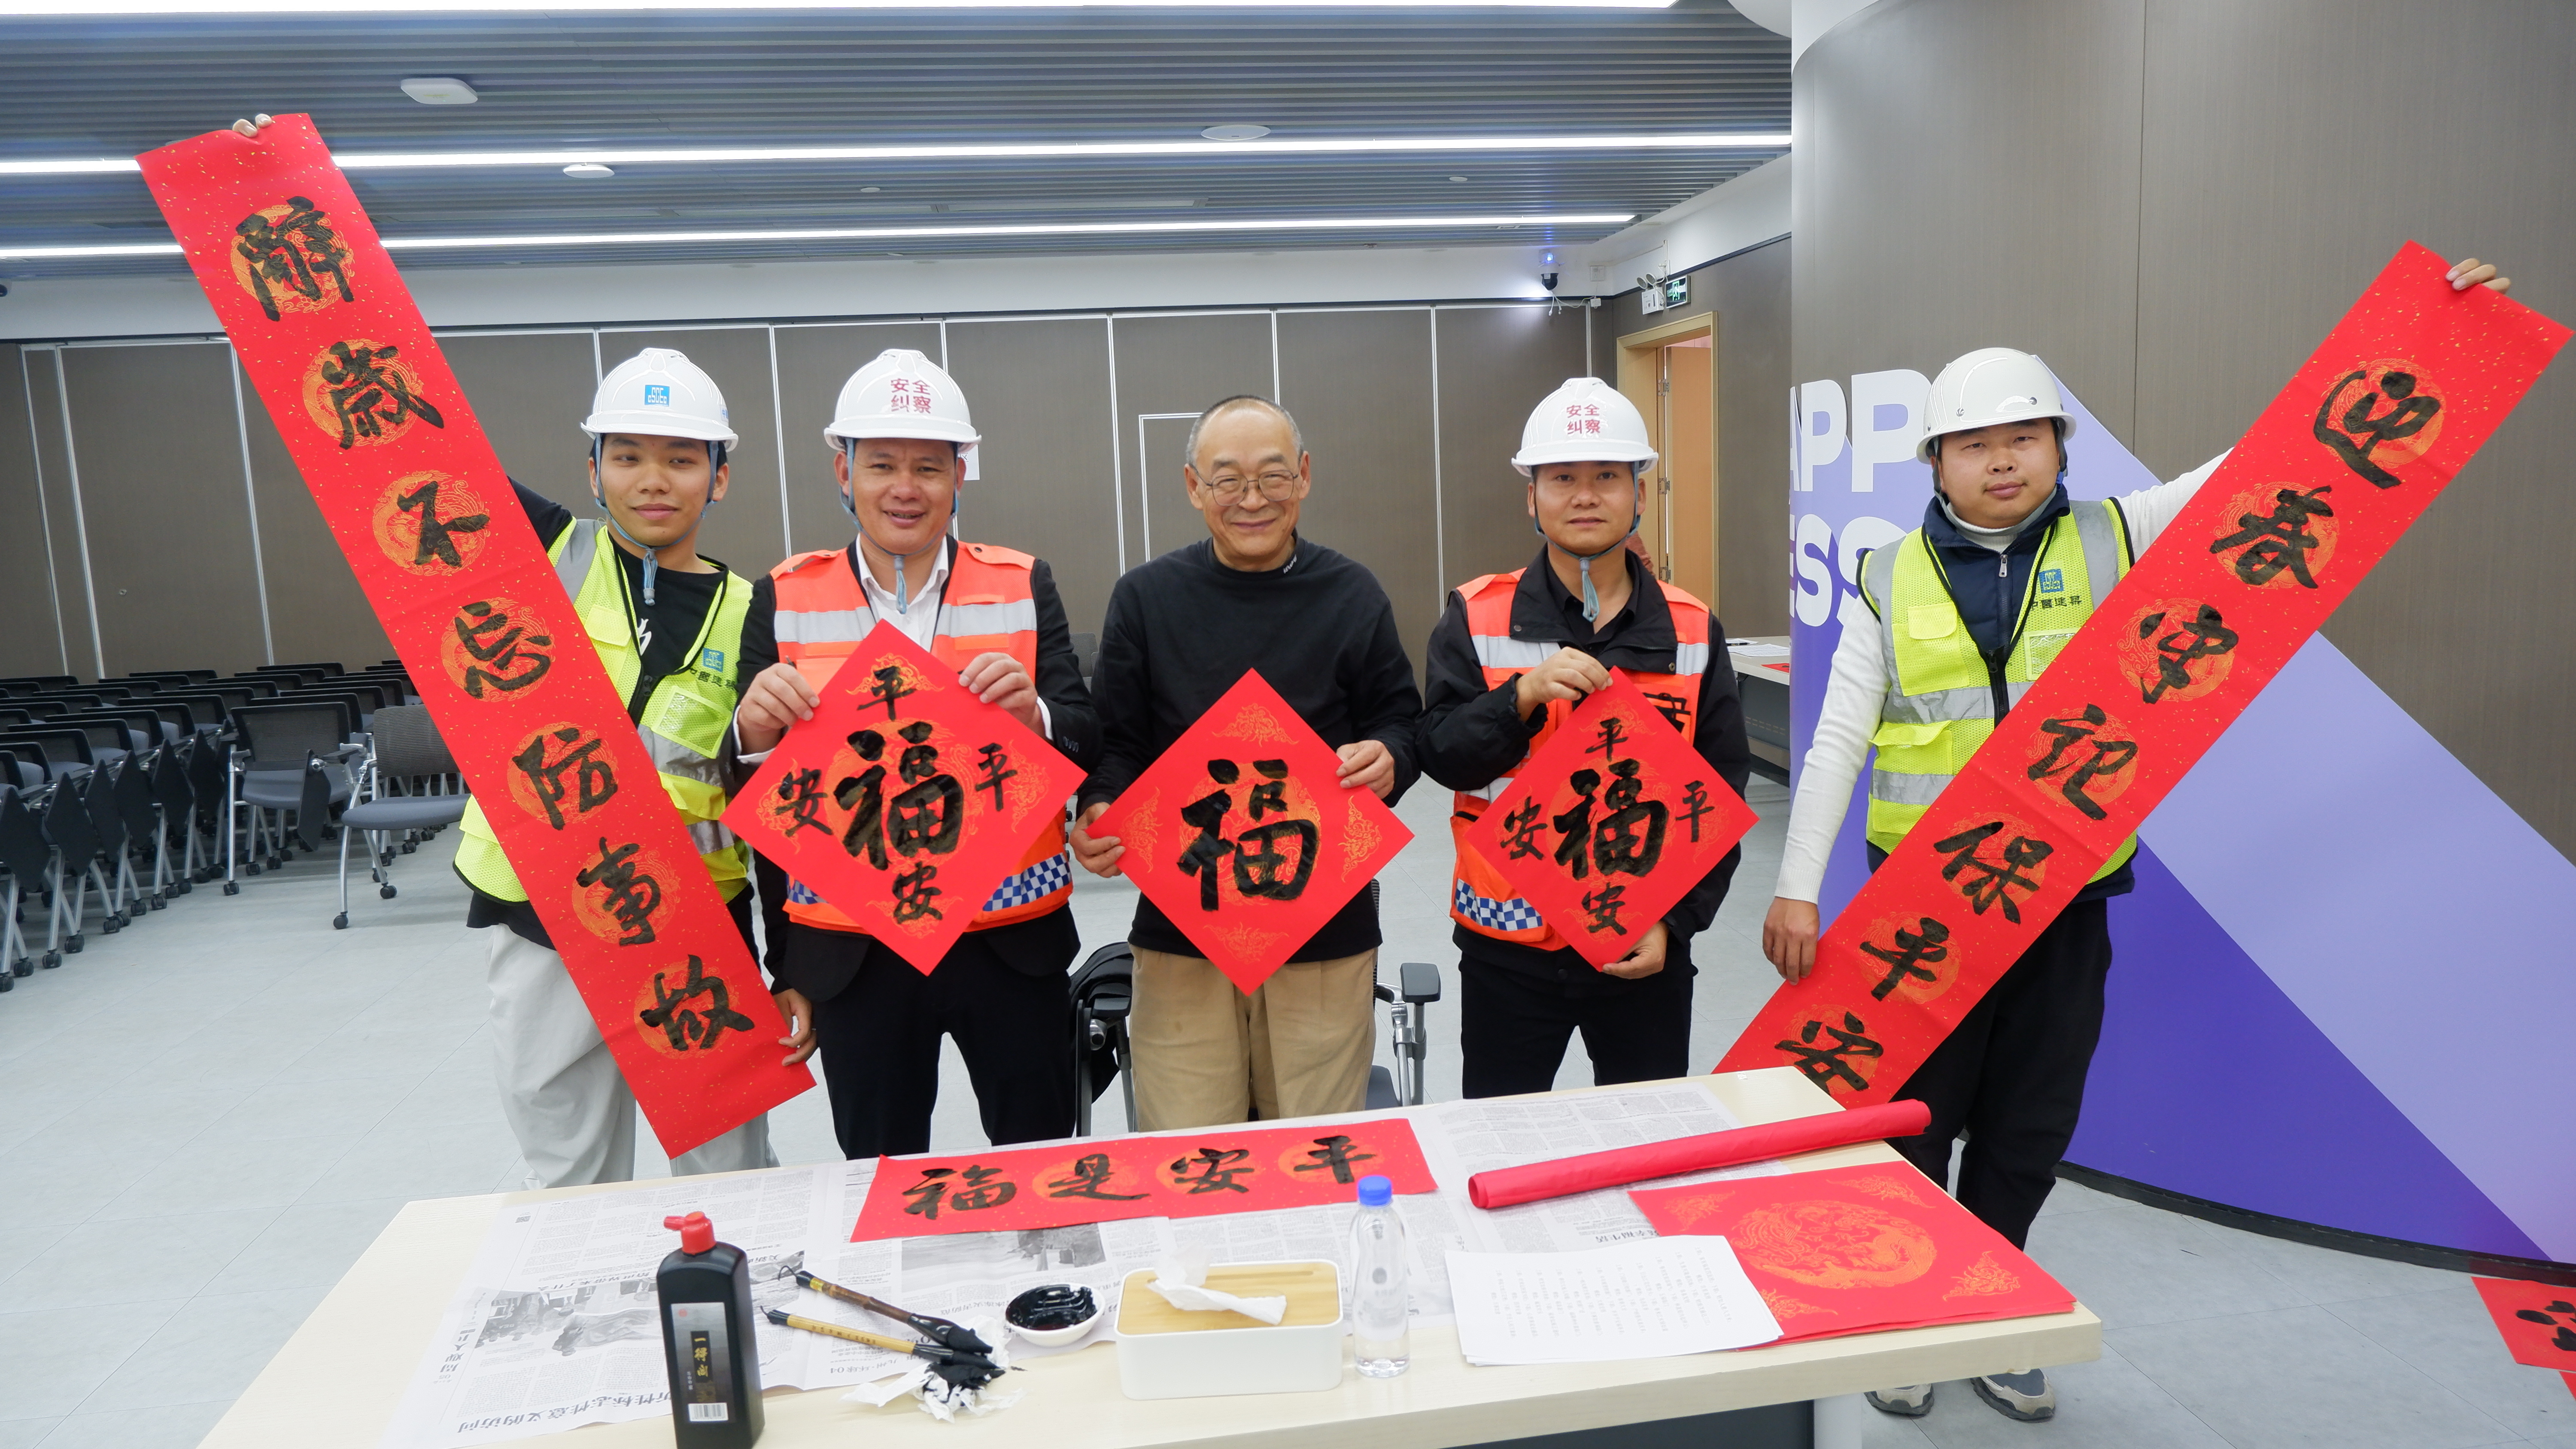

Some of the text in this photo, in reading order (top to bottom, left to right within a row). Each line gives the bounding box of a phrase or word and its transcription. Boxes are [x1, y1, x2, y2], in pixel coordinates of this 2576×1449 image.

[890, 378, 931, 395] 安全
[890, 394, 931, 414] 纠察
[1566, 404, 1600, 418] 安全
[1567, 419, 1601, 435] 纠察
[857, 666, 917, 721] 平
[1585, 718, 1628, 761] 平
[775, 768, 833, 837] 安
[834, 721, 964, 871] 福
[975, 743, 1018, 812] 平
[1176, 758, 1320, 912] 福
[1500, 796, 1548, 861] 安
[1553, 758, 1669, 881] 福
[1675, 780, 1716, 843] 平
[891, 862, 943, 924] 安
[1581, 883, 1628, 937] 安
